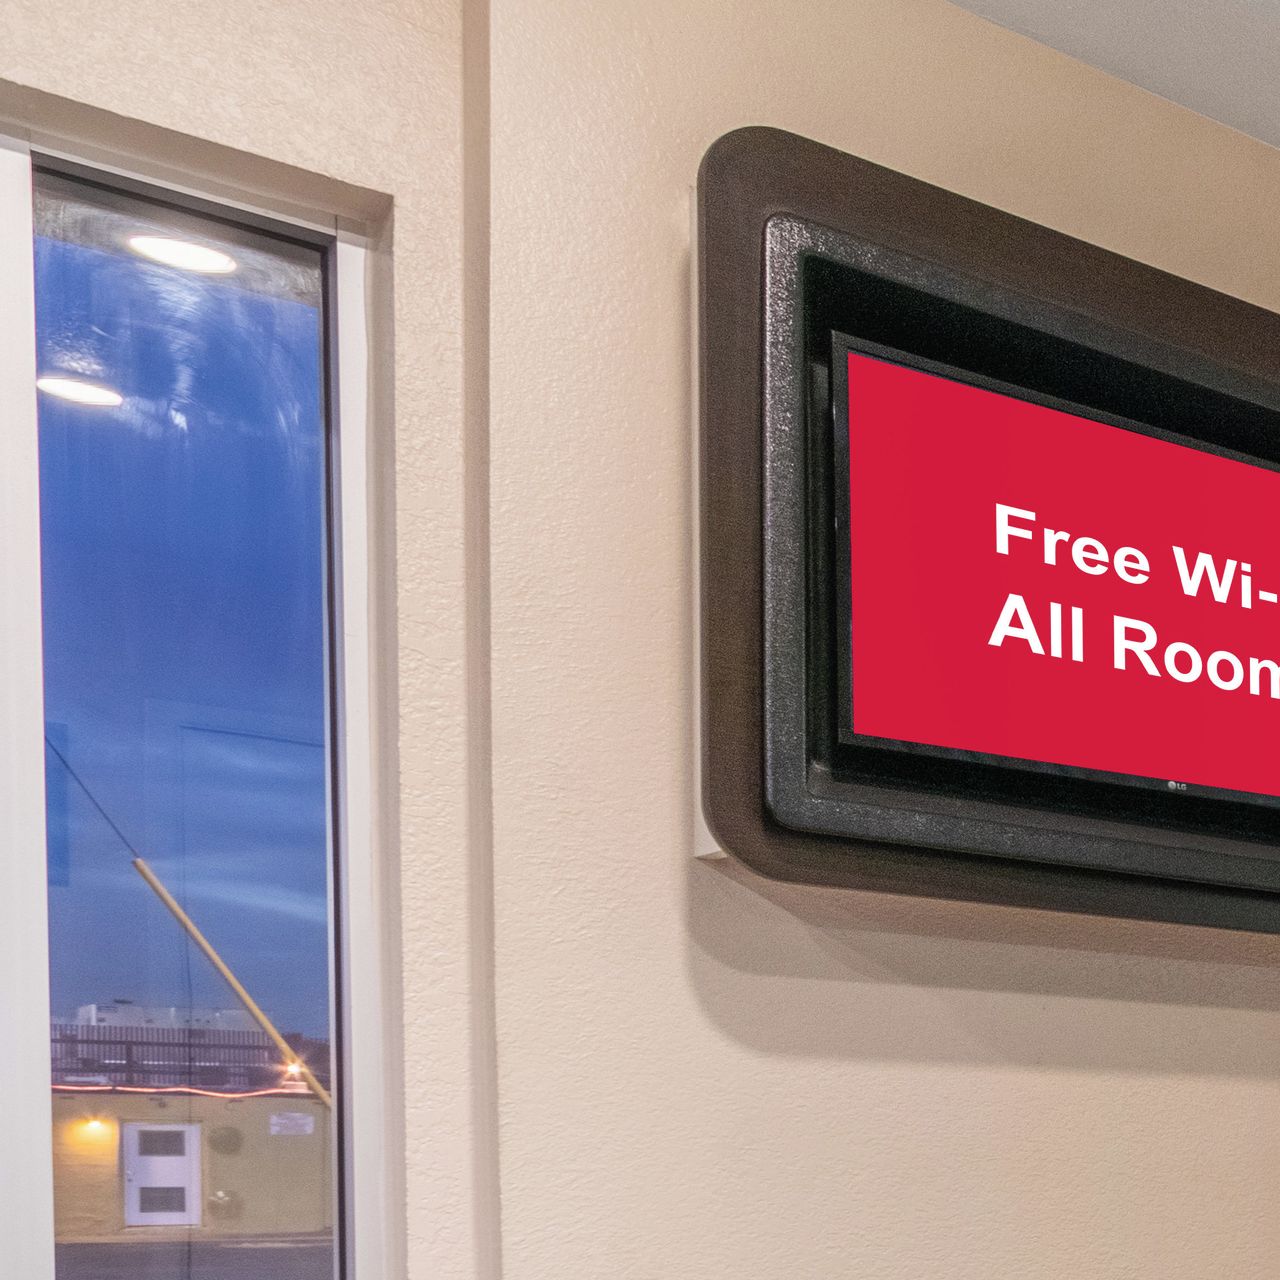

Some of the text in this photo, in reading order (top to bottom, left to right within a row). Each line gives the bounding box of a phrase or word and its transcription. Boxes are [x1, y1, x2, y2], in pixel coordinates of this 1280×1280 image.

[995, 502, 1151, 586] Free
[988, 592, 1084, 663] All
[1177, 783, 1187, 791] LG
